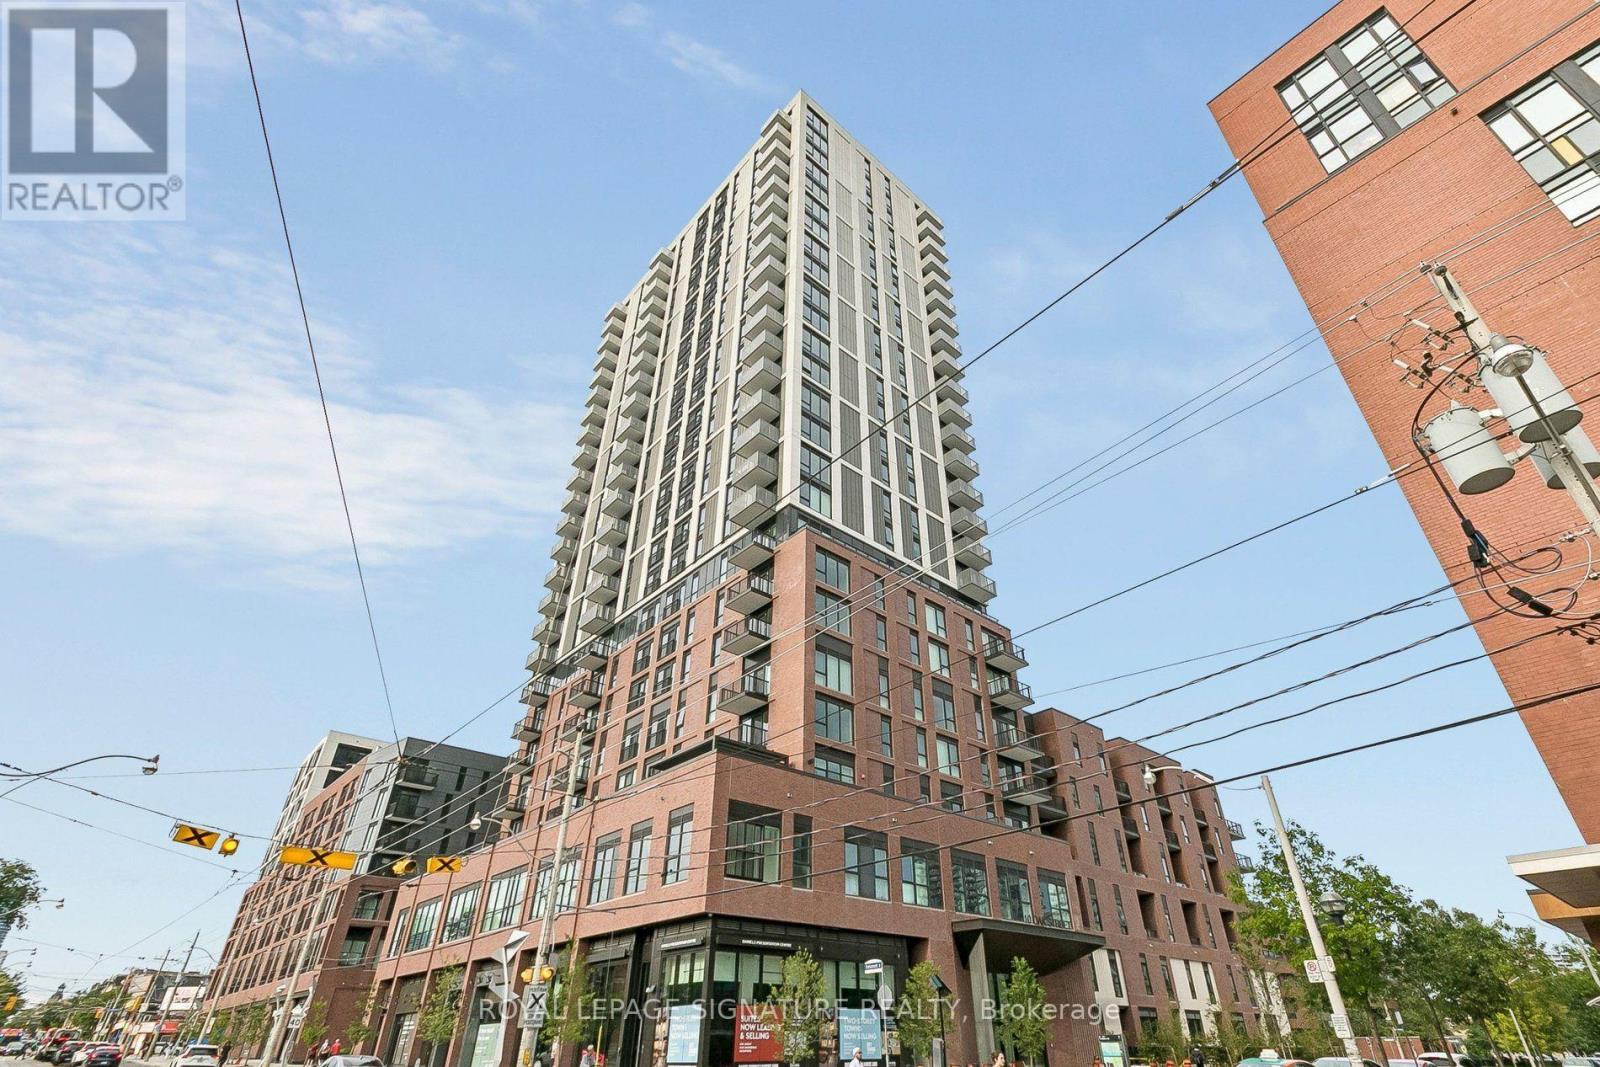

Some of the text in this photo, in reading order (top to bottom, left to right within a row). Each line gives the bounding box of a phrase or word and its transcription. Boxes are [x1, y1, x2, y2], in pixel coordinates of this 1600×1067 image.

[740, 1023, 756, 1031] NOW
[739, 1032, 770, 1040] & SELLING
